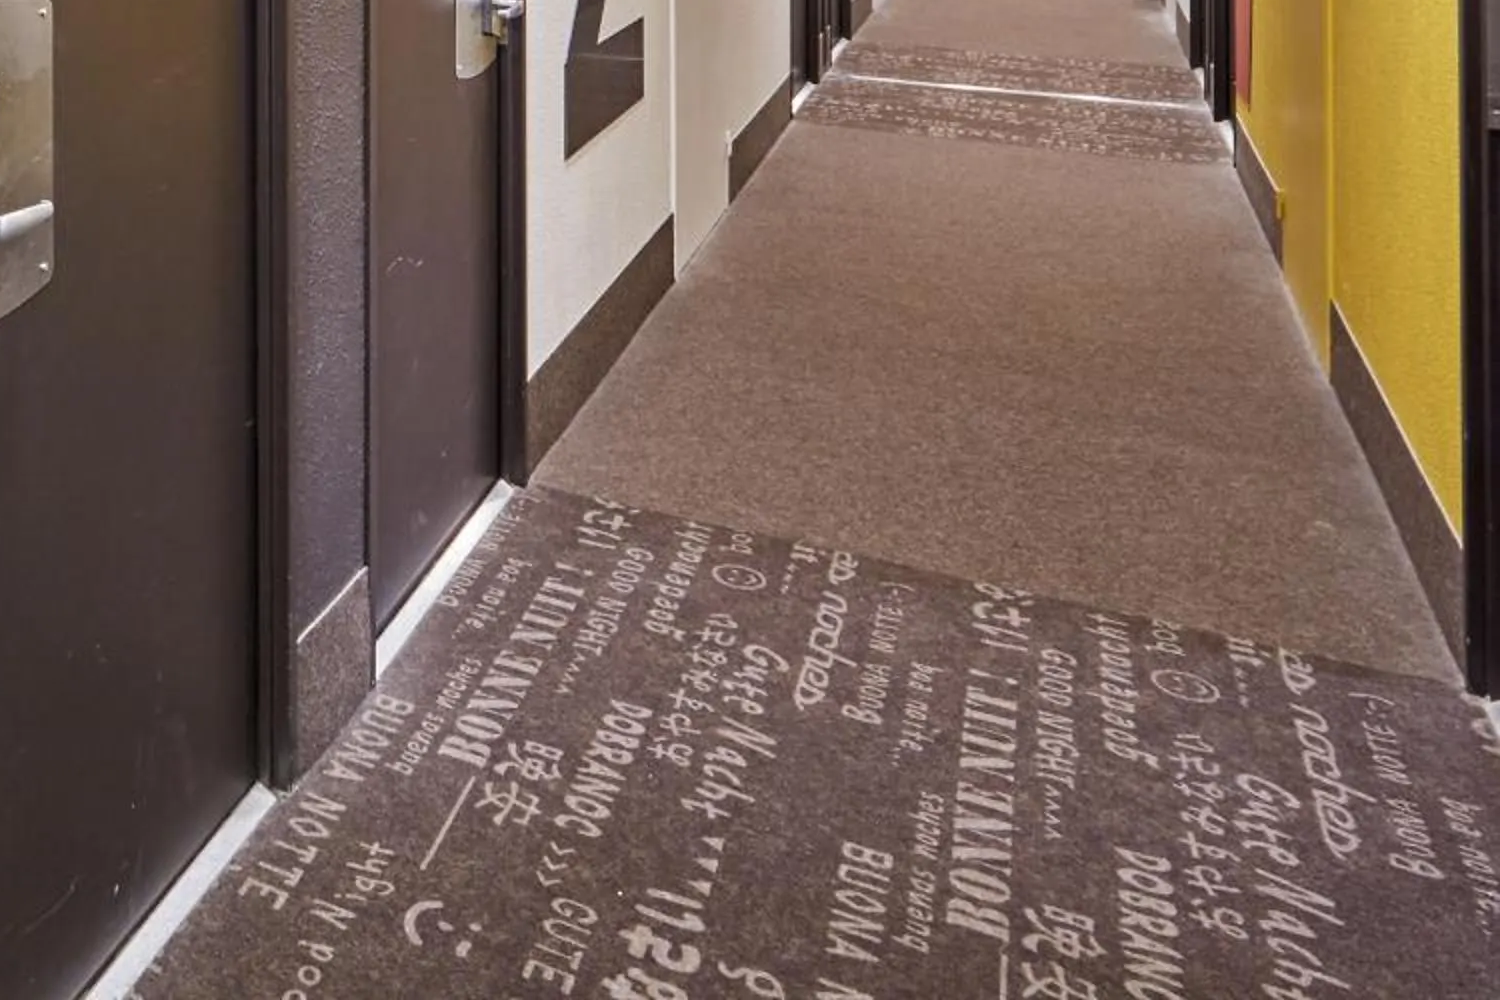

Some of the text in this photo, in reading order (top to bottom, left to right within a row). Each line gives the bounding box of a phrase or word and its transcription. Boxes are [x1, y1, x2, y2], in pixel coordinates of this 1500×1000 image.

[573, 547, 654, 656] GOOD NIGHT
[645, 521, 713, 641] goedenacht
[386, 657, 482, 775] buenas noches
[437, 650, 542, 767] BONNE
[510, 577, 584, 650] NUIT
[647, 613, 738, 767] おやすみなさい
[681, 644, 790, 819] Gute Nacht
[960, 686, 1017, 781] NUIT
[1034, 648, 1080, 789] GOOD NIGHT
[1085, 614, 1160, 769] goedenacht
[238, 692, 415, 910] BUONA NOTTE
[554, 699, 652, 837] DOBRANOC
[1168, 733, 1248, 939] おやすみなさい
[1232, 774, 1301, 866] Gute
[1290, 703, 1377, 859] noches
[282, 842, 395, 1000] ood Night
[826, 841, 893, 962] BUONA
[892, 791, 944, 953] buenas noches
[946, 781, 1014, 942] BONNE
[522, 898, 598, 994] GUTE
